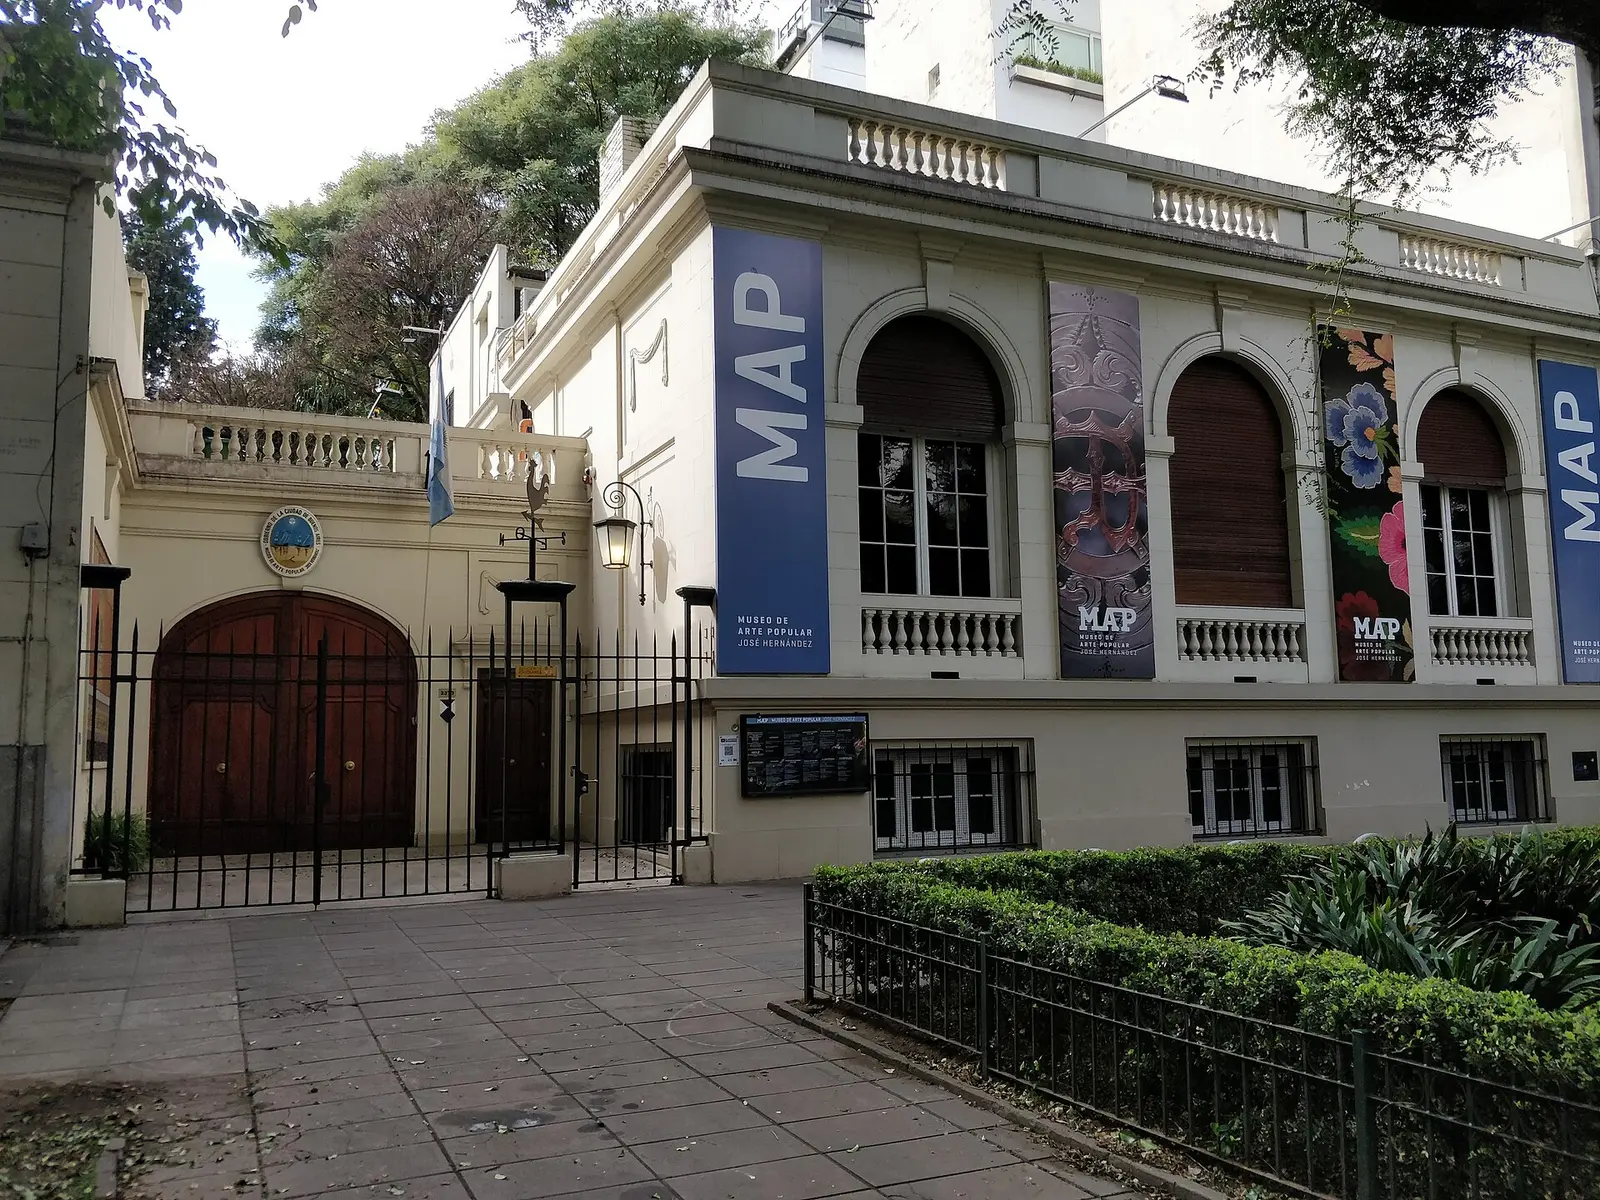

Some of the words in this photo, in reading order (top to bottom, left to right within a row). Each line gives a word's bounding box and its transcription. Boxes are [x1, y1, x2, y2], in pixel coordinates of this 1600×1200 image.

[733, 272, 808, 483] MAP
[1553, 390, 1600, 542] MAP
[737, 616, 772, 624] MUSEO
[776, 617, 788, 625] DE
[1078, 606, 1137, 632] MAP
[1353, 616, 1400, 640] MAP
[738, 627, 763, 636] ARTE
[738, 638, 759, 647] JOSÉ
[763, 638, 813, 648] HERNÁNDEZ
